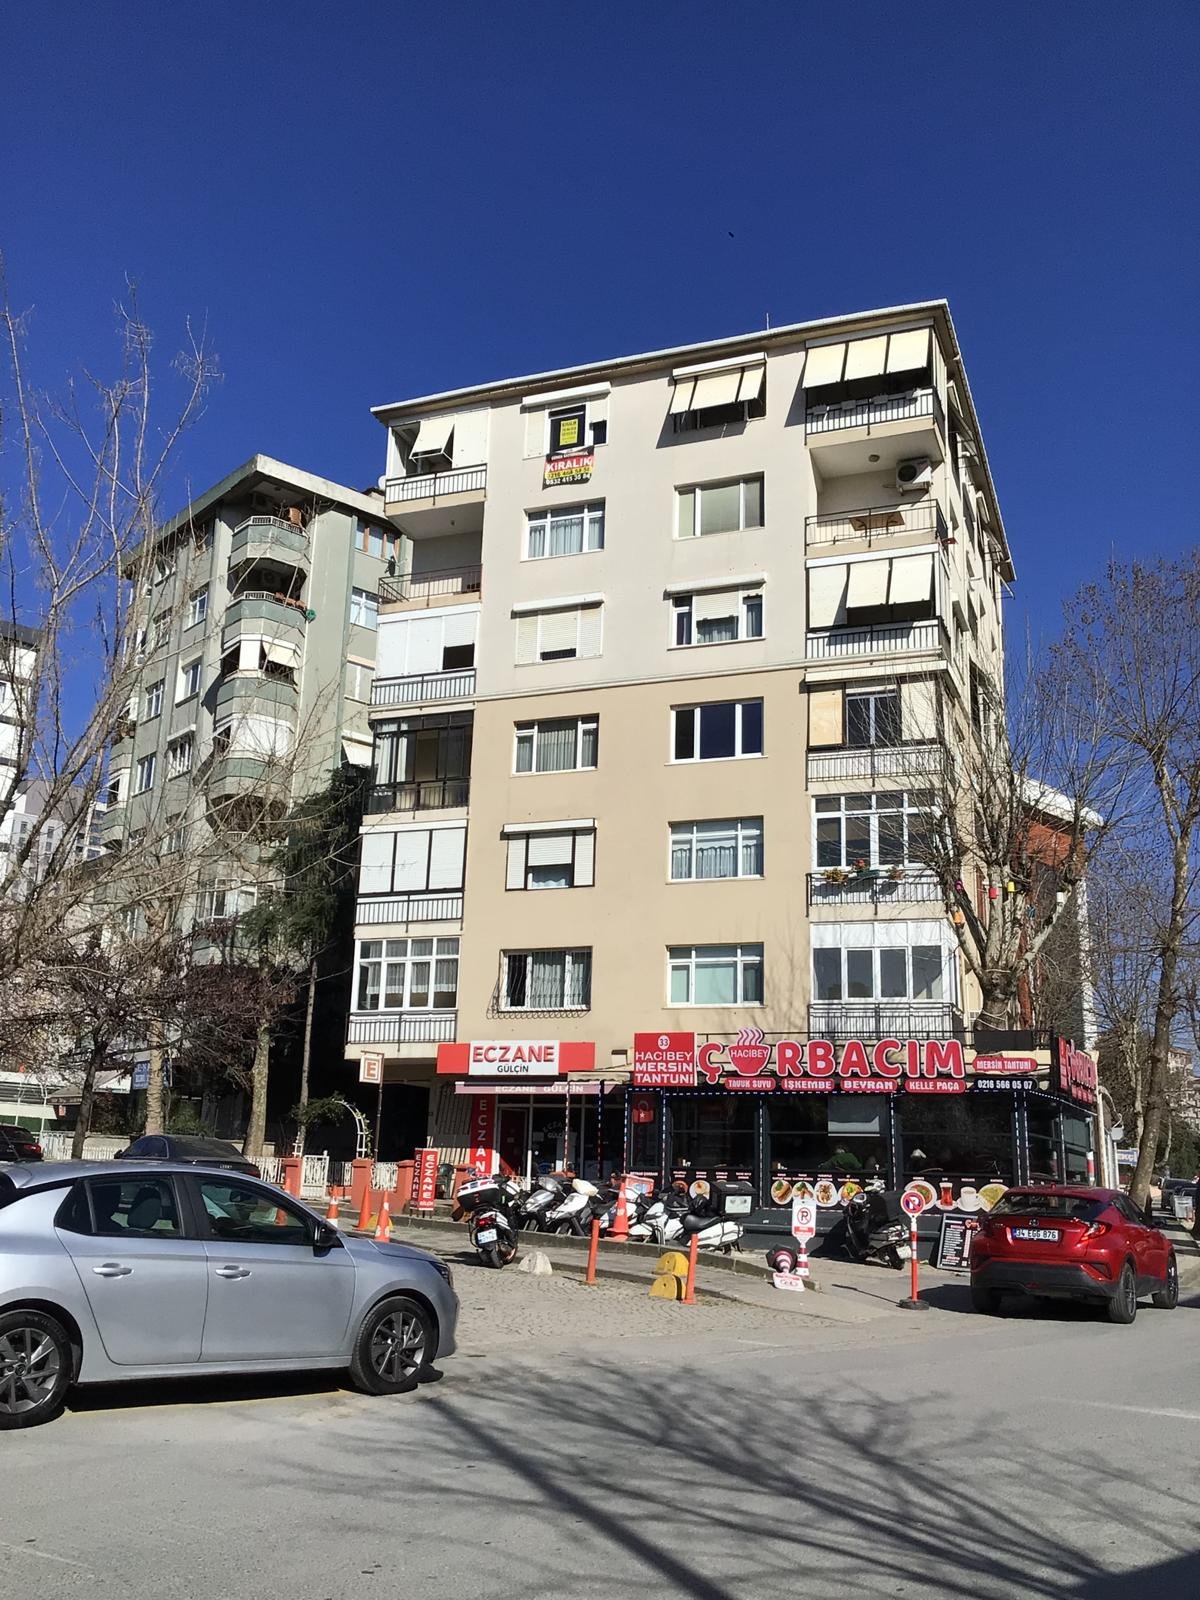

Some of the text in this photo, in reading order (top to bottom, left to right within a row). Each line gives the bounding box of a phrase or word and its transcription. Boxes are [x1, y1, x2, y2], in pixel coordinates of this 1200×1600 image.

[545, 456, 592, 472] KIRALIK
[659, 1038, 669, 1047] 33
[472, 1045, 555, 1063] ECZANE
[635, 1051, 693, 1061] HACIBEY
[730, 1049, 768, 1058] HACIBEY
[496, 1063, 529, 1075] GÜLÇİN
[728, 1080, 772, 1088] TAVUK SUYU
[784, 1079, 832, 1090] İŞKEMBE
[843, 1080, 893, 1090] BEYRAN
[909, 1081, 959, 1092] KELLE PAÇA
[977, 1079, 994, 1089] 0216
[1012, 1080, 1022, 1089] 05
[1023, 1080, 1033, 1090] 07
[412, 1154, 421, 1198] ECZANE
[422, 1154, 435, 1199] ECZANE
[1015, 1229, 1026, 1237] 34
